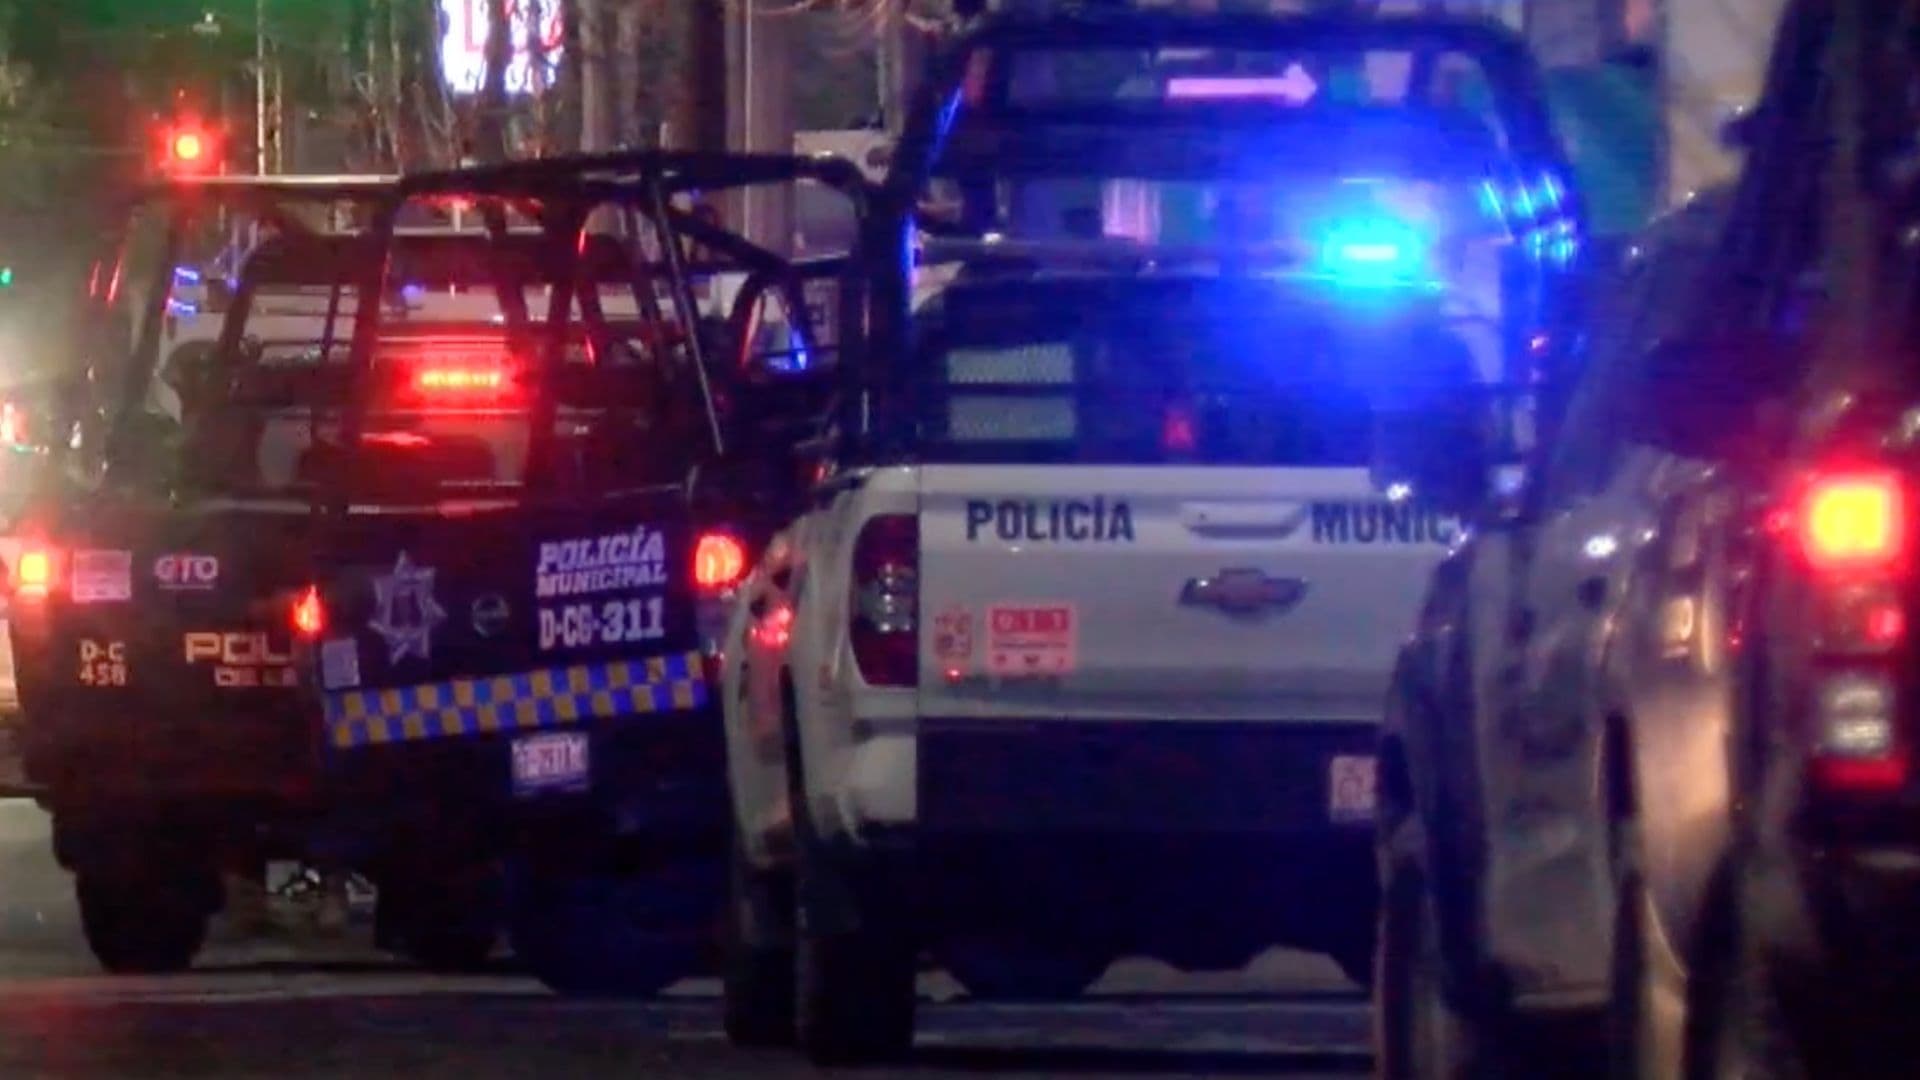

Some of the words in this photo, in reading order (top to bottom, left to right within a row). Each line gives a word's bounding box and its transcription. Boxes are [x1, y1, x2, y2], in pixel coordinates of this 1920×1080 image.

[966, 495, 1134, 541] POLICÍA
[154, 555, 219, 583] GTO
[536, 564, 667, 597] MUNICIPAL
[79, 639, 126, 662] D-C
